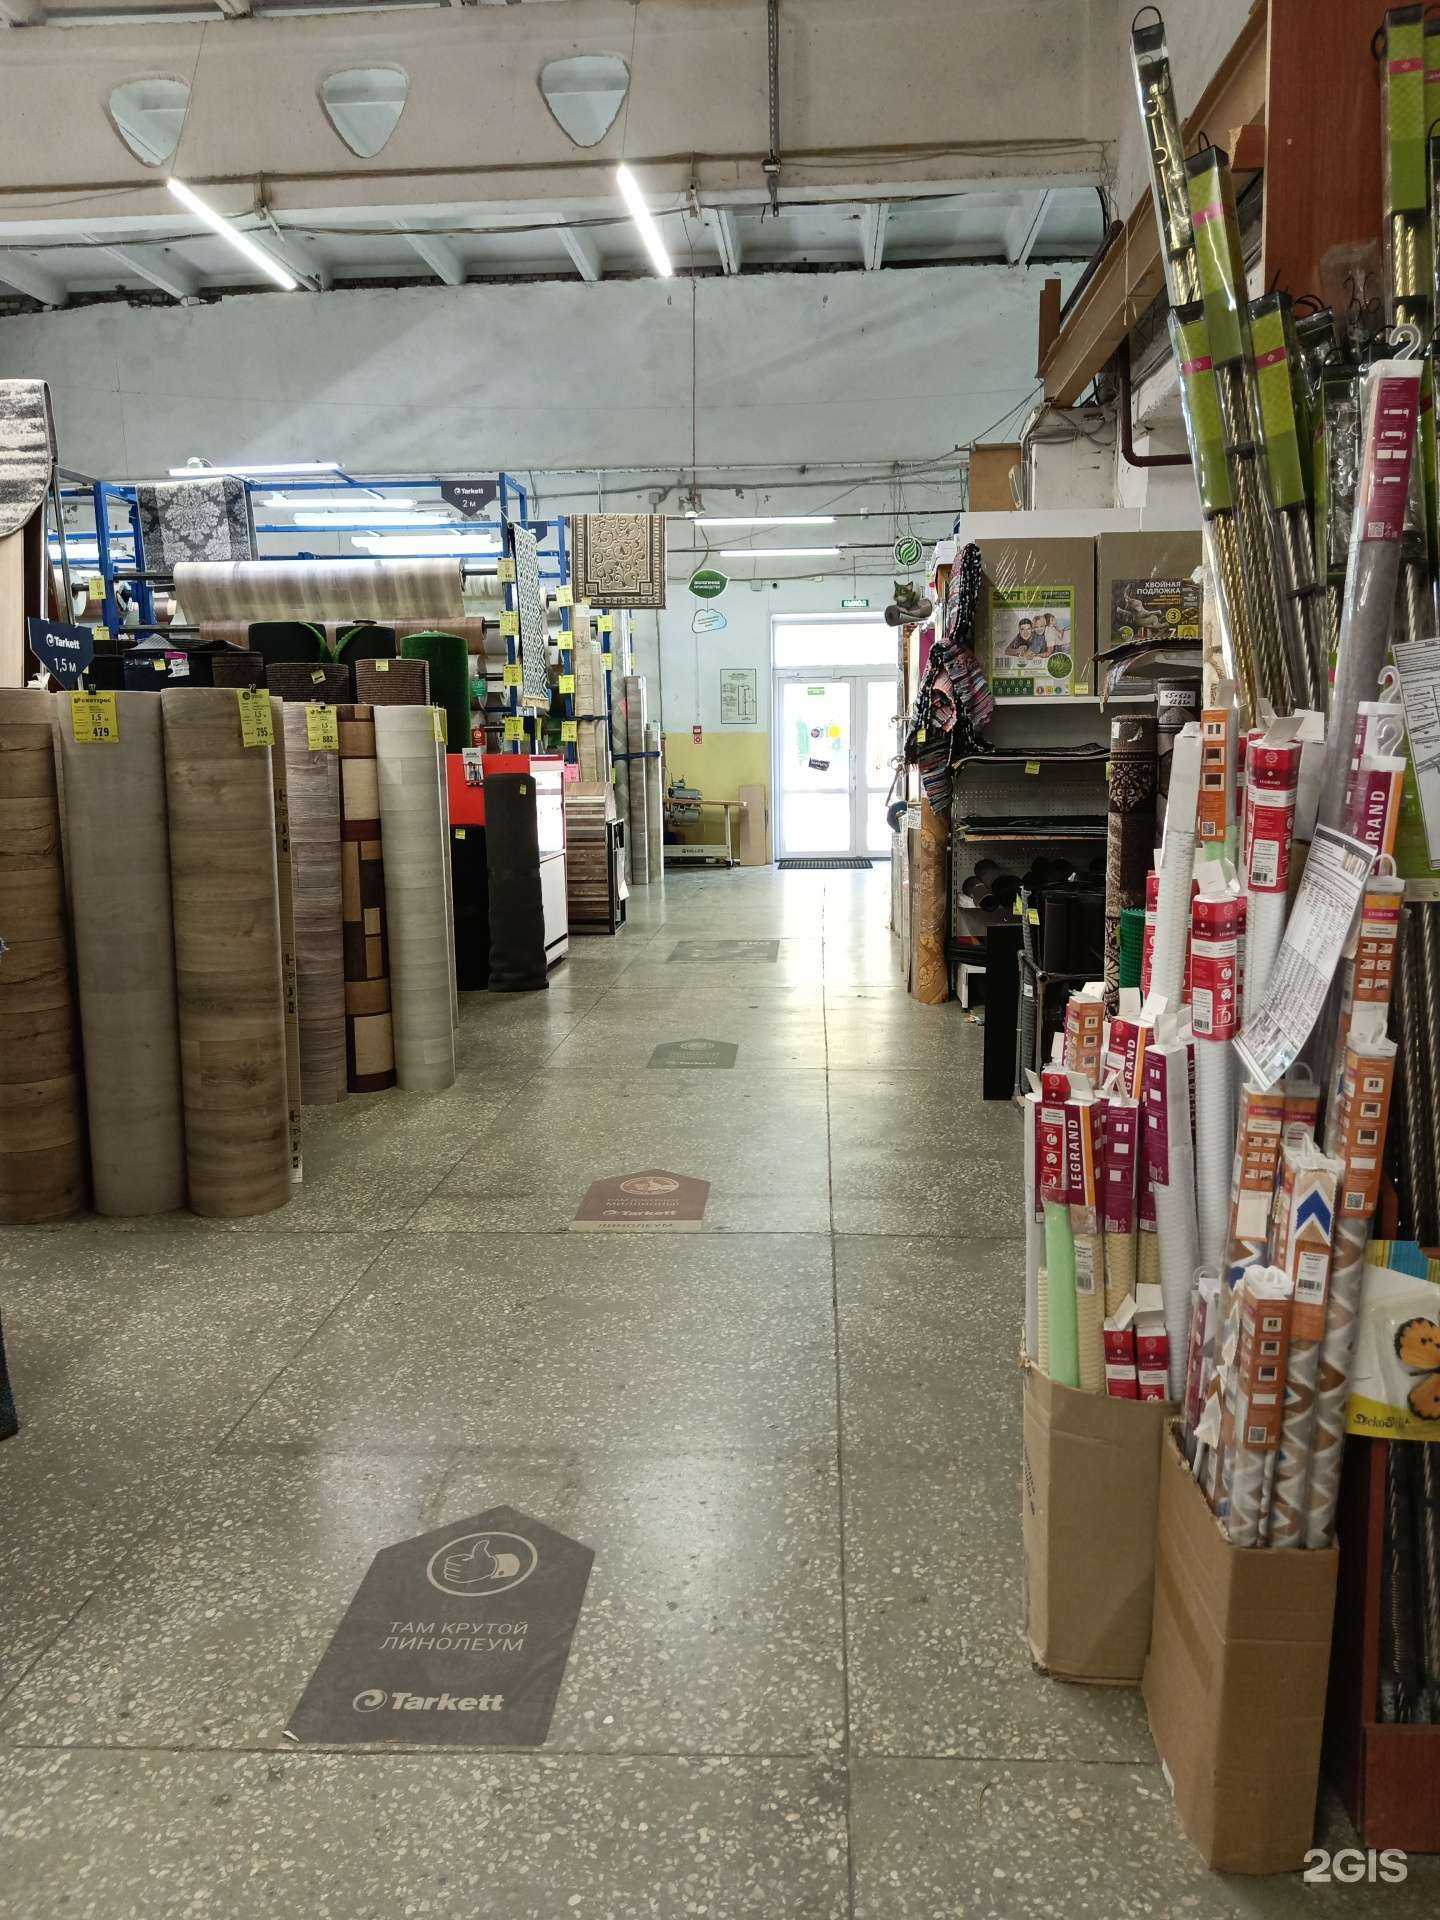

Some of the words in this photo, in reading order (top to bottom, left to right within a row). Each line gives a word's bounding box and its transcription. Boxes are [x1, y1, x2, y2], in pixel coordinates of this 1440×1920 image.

[461, 487, 484, 495] Tarkett
[462, 499, 469, 508] 2
[1137, 587, 1181, 596] ПОДЛОЖКА
[53, 635, 80, 650] Tarkett
[54, 657, 67, 673] 1,5
[91, 713, 102, 721] 1,5
[92, 727, 110, 737] 479
[1125, 1039, 1136, 1093] GRAND
[1067, 1119, 1082, 1190] LEGRAND
[389, 1621, 433, 1635] ТАМ
[440, 1619, 529, 1635] КРУТОЙ
[379, 1636, 525, 1652] ЛИНОЛЕУМ
[391, 1692, 505, 1712] Tarkett
